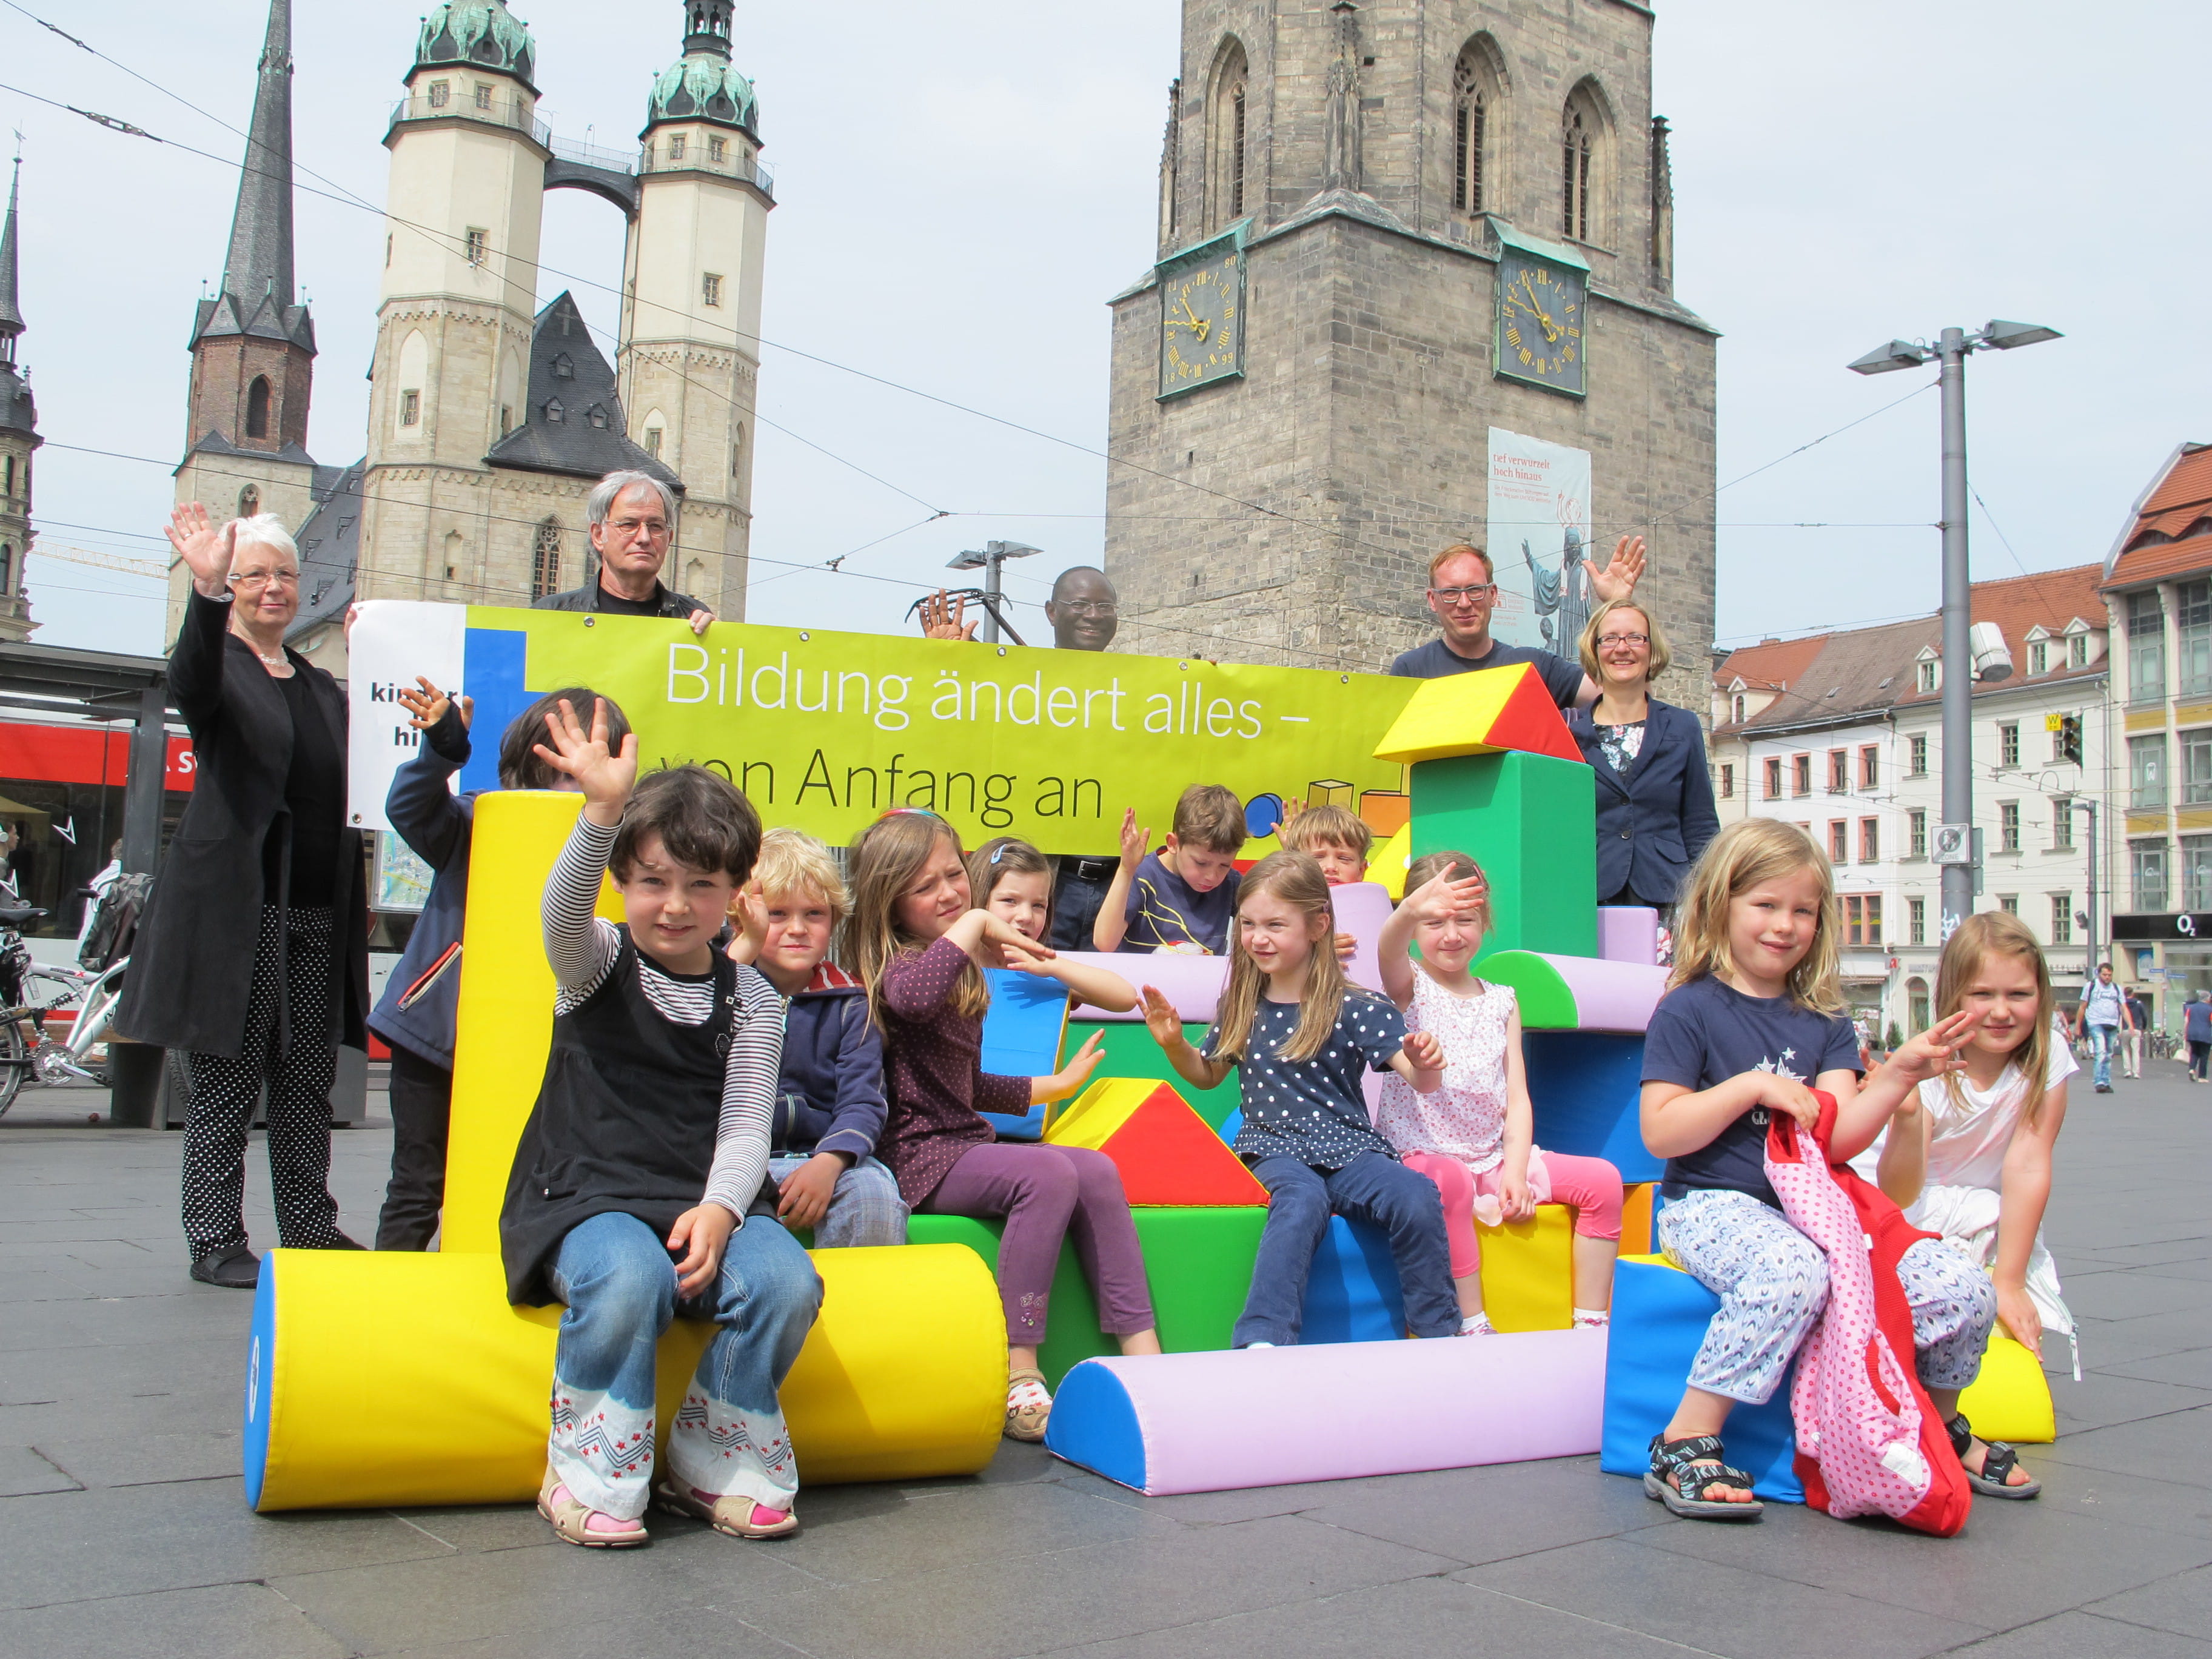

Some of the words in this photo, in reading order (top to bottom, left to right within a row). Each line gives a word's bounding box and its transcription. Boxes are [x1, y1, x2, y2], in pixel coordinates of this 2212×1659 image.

[1493, 453, 1507, 463] tief
[1508, 457, 1550, 469] verwurzelt
[1494, 464, 1513, 477] hoch
[1515, 468, 1542, 481] hinaus
[668, 643, 913, 731] Bildung
[931, 670, 1127, 731] ändert
[1144, 681, 1262, 739] alles
[2048, 714, 2059, 725] W
[795, 749, 1017, 828] Anfang
[1035, 777, 1101, 818] an
